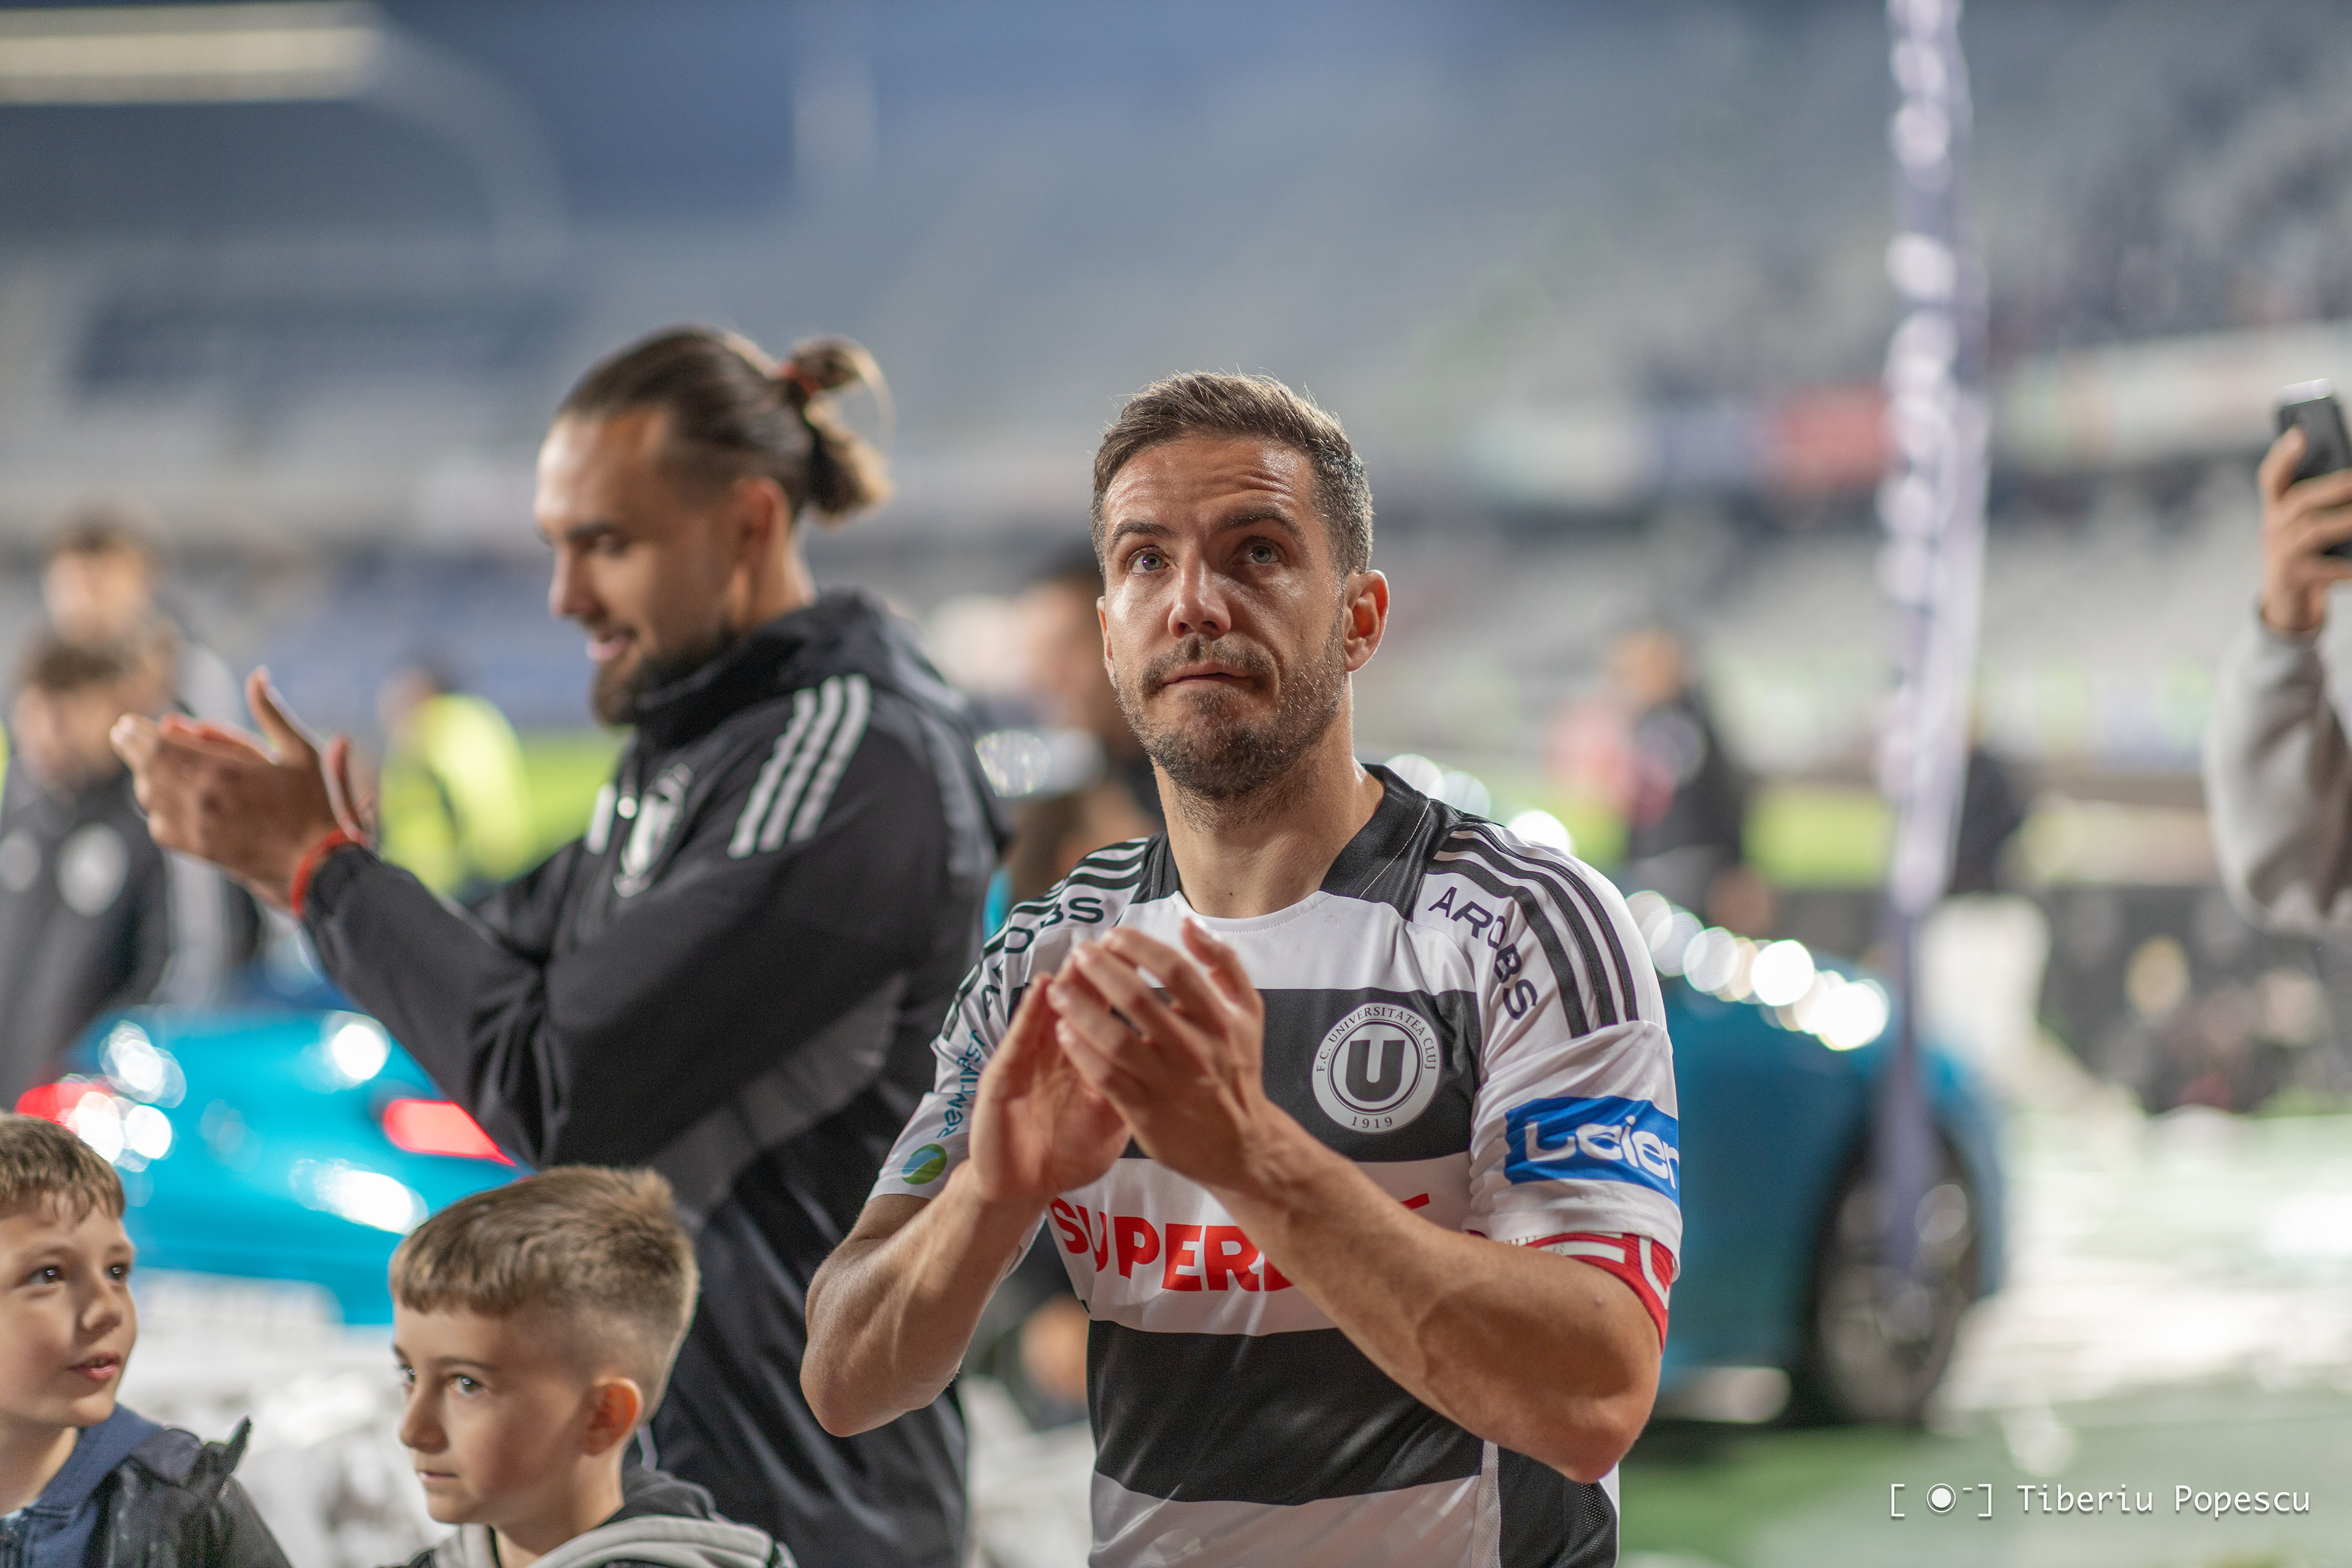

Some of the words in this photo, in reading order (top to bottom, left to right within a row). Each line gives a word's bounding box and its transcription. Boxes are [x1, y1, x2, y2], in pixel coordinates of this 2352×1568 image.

[1428, 886, 1538, 1020] AROBS
[1328, 1006, 1426, 1043] UNIVERSITATEA
[1423, 1038, 1436, 1070] CLUJ
[1346, 1039, 1406, 1102] U
[1351, 1116, 1393, 1129] 1919
[1524, 1115, 1679, 1190] Leier
[1050, 1193, 1430, 1292] SUPER
